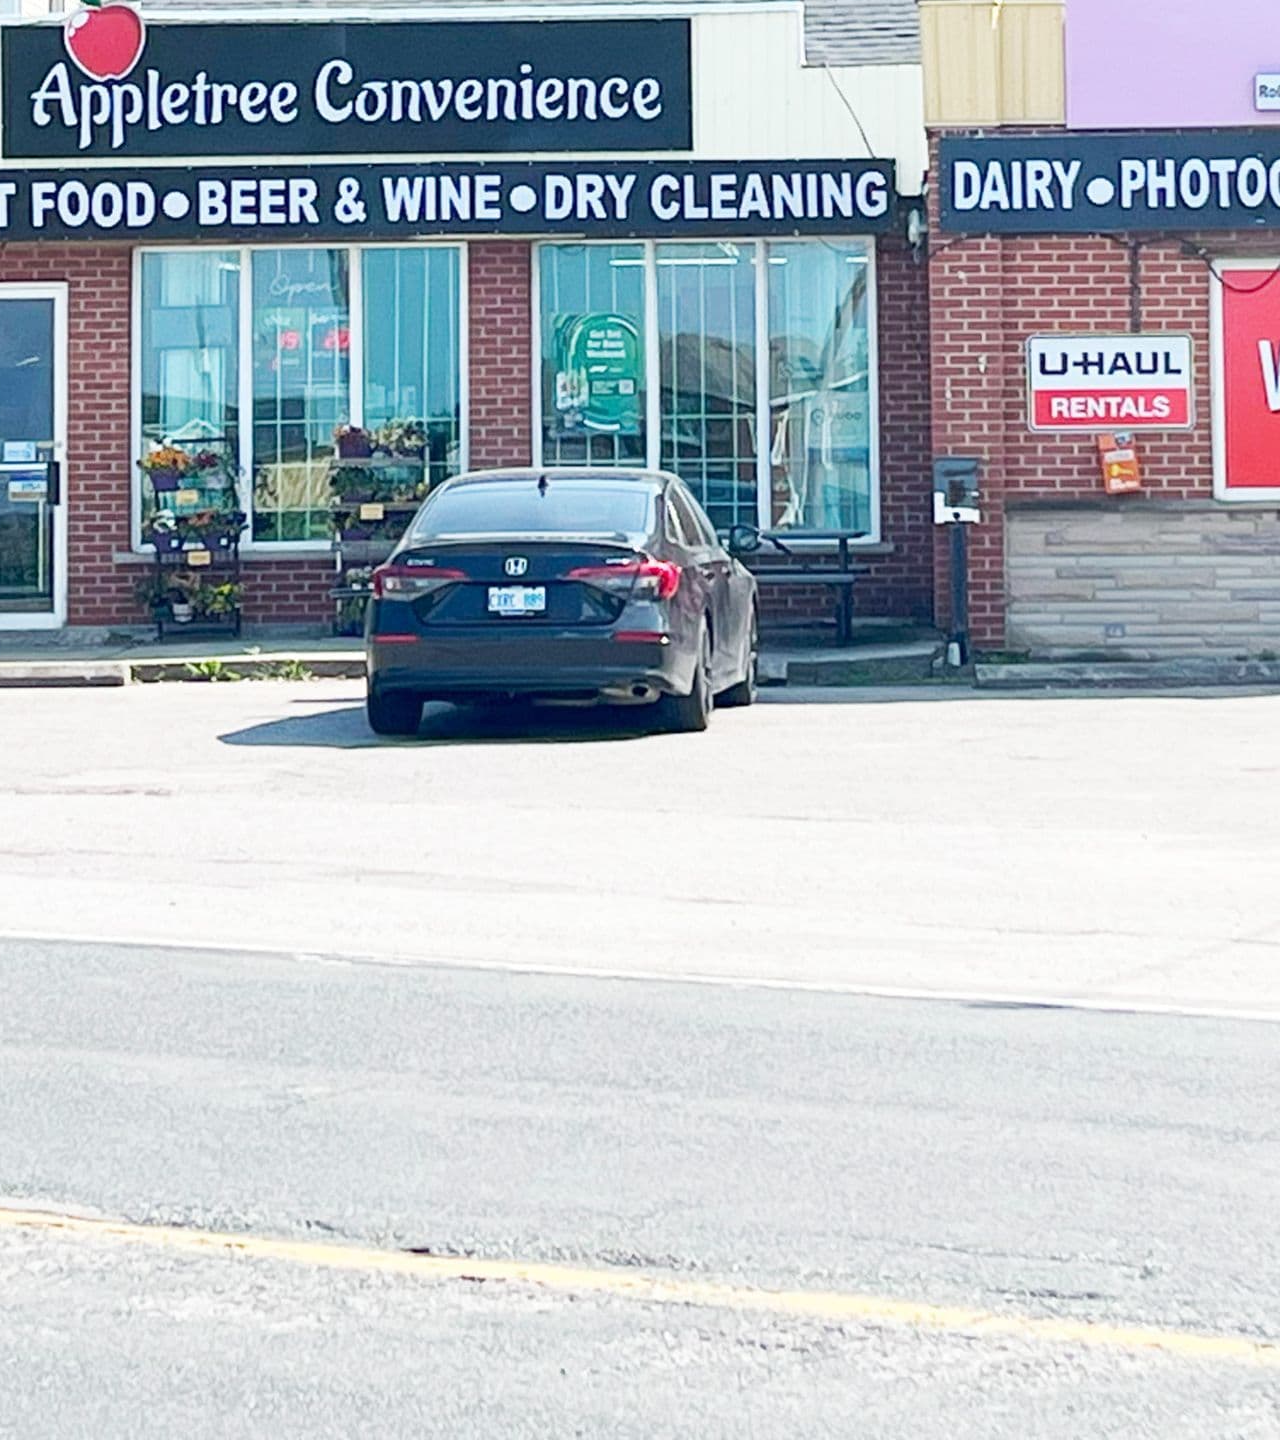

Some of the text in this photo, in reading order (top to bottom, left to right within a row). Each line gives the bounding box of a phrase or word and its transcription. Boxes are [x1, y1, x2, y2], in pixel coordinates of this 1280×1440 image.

[30, 60, 662, 150] Appletree Convenience
[31, 180, 156, 227] FOOD
[198, 179, 320, 225] BEER
[334, 176, 367, 222] &
[382, 175, 502, 220] WINE
[543, 174, 636, 220] DRY
[651, 171, 888, 219] CLEANING
[953, 159, 1082, 211] DAIRY
[1038, 351, 1182, 377] U-HAUL
[1051, 396, 1170, 419] RENTALS
